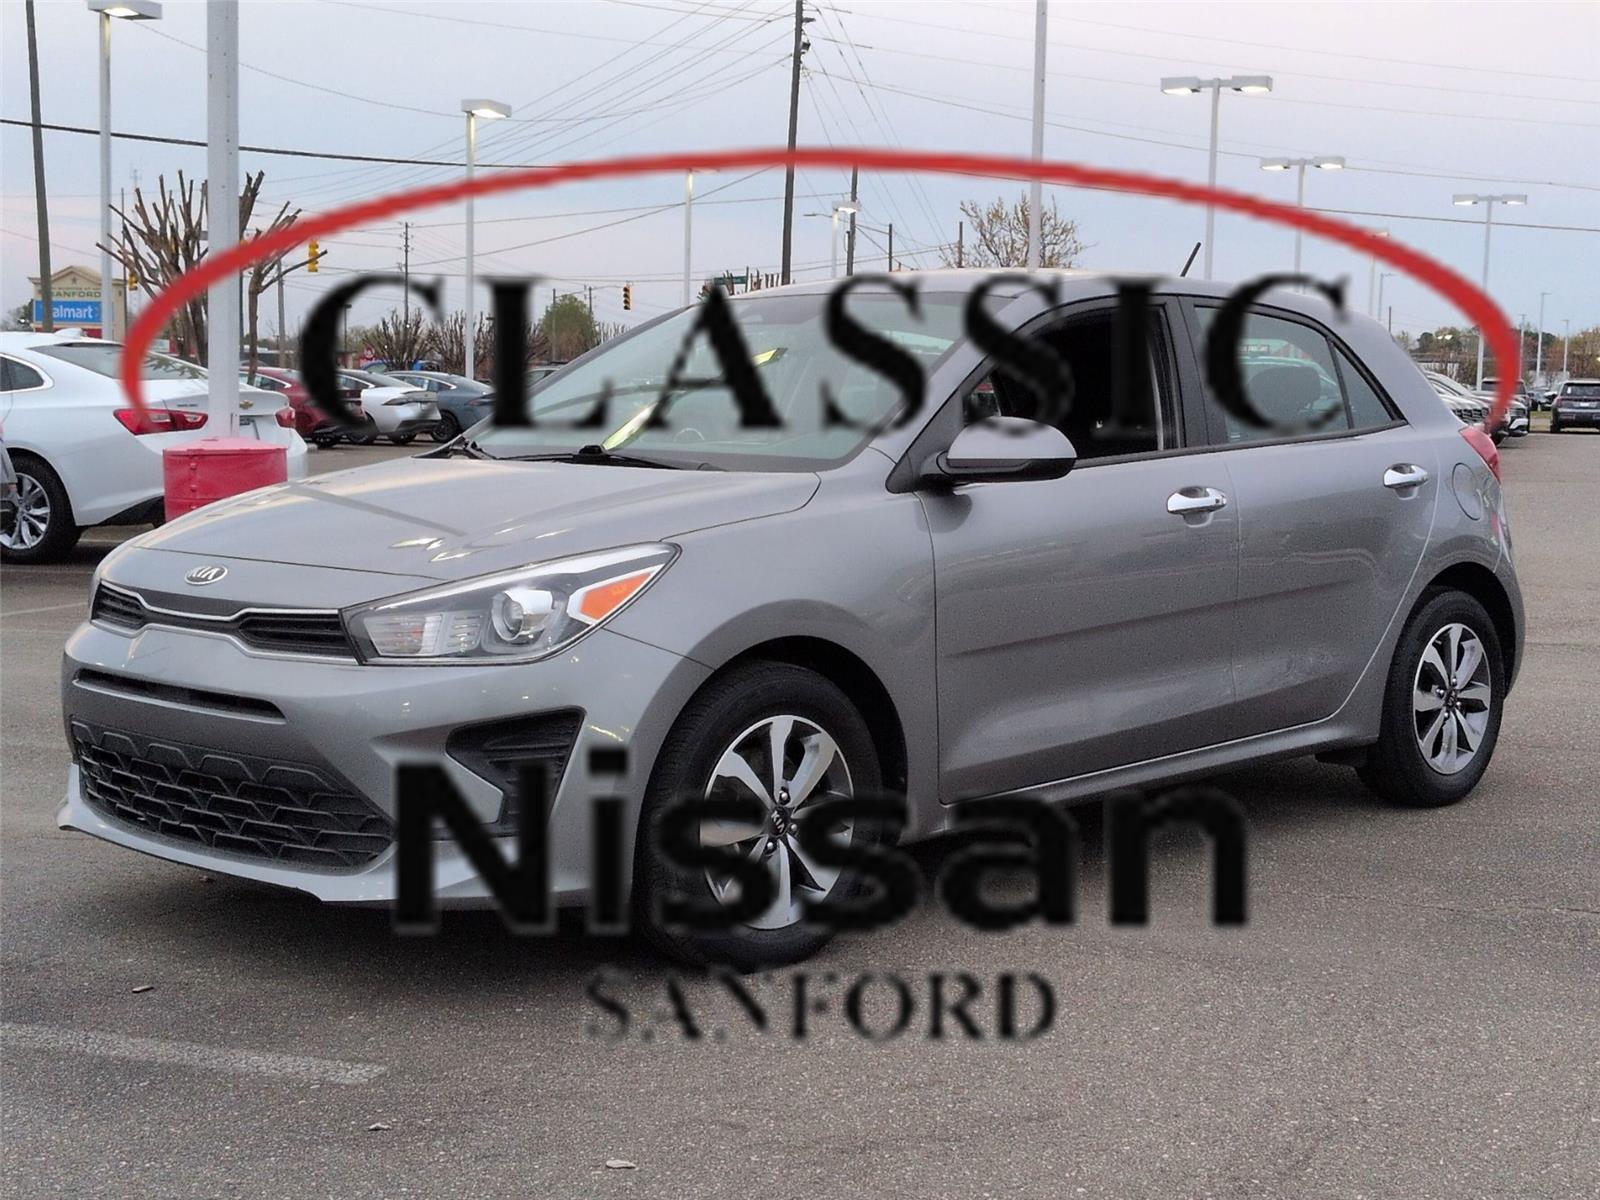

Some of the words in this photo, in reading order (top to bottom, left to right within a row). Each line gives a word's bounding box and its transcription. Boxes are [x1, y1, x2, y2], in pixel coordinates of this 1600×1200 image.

[51, 290, 101, 298] ANFORD
[52, 305, 92, 318] almart
[186, 566, 220, 580] KIA
[771, 810, 785, 833] KIA
